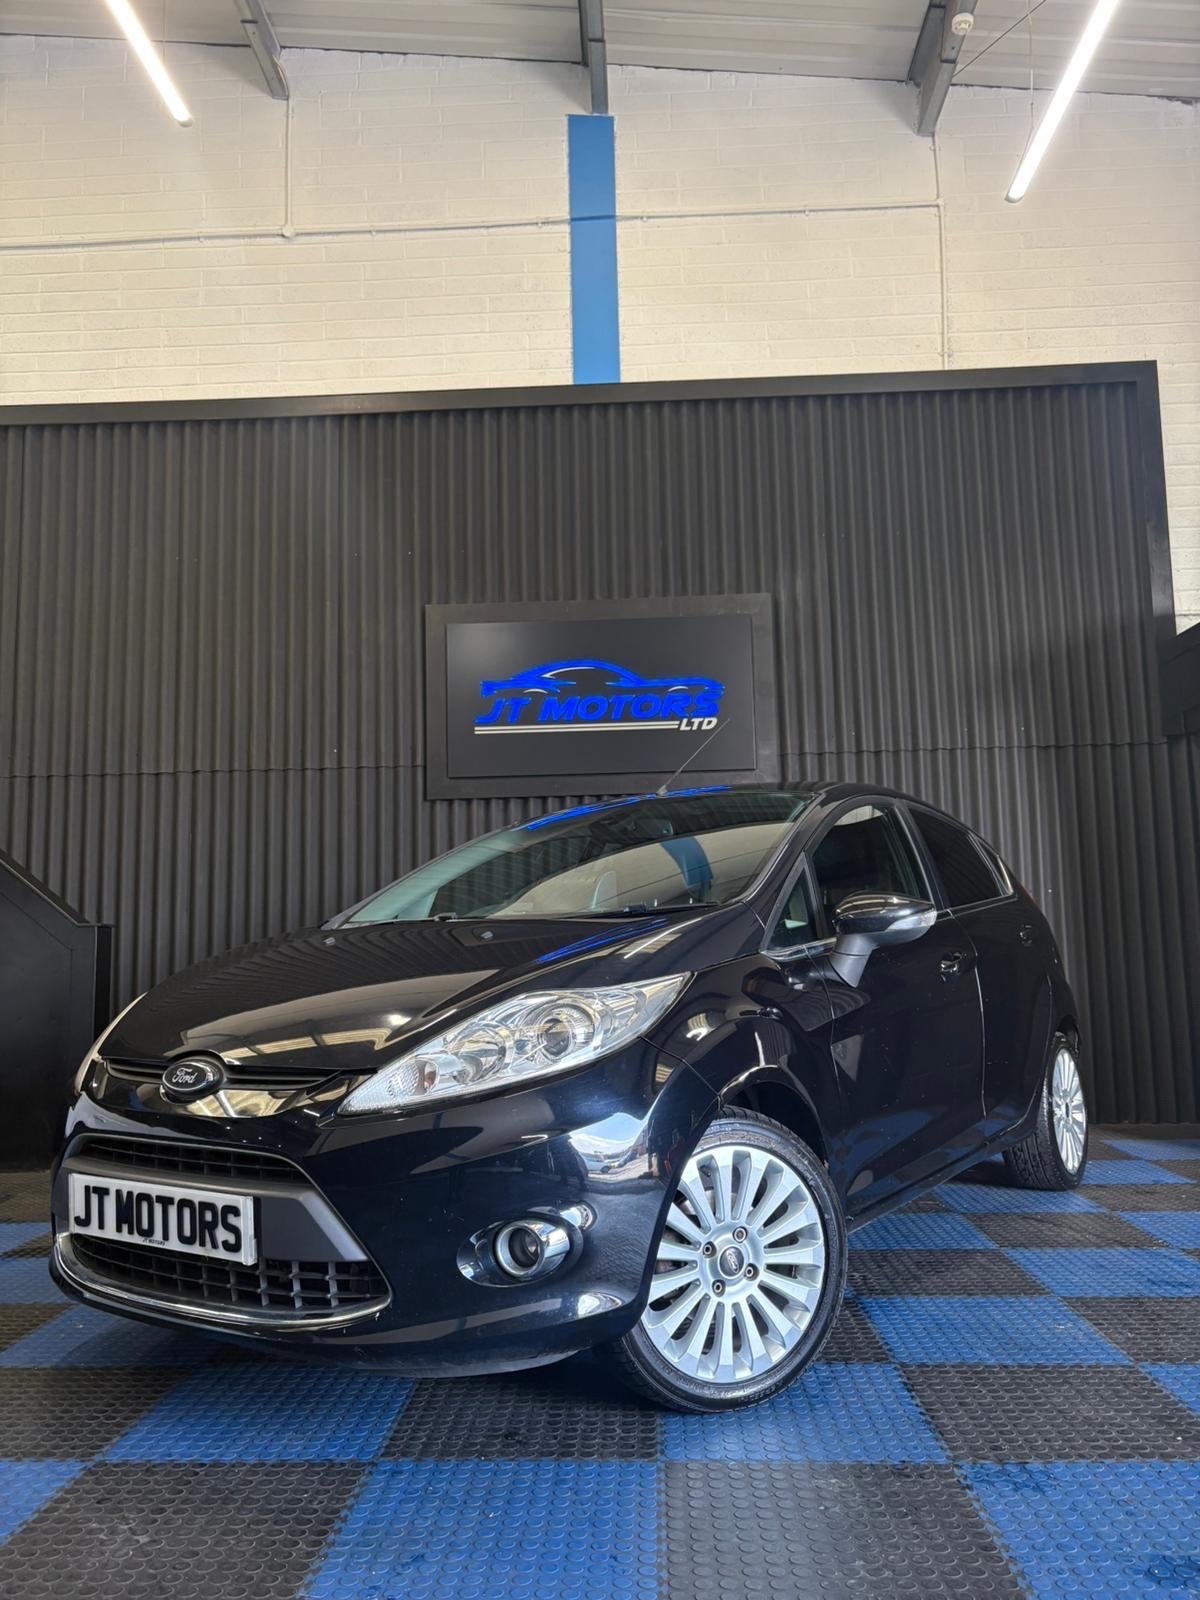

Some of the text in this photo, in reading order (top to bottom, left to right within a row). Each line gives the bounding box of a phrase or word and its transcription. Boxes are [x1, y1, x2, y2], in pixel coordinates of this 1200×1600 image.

[474, 691, 724, 724] JT MOTORS
[680, 718, 718, 731] LTD
[171, 1067, 198, 1084] Ford
[74, 1185, 242, 1253] JT MOTORS
